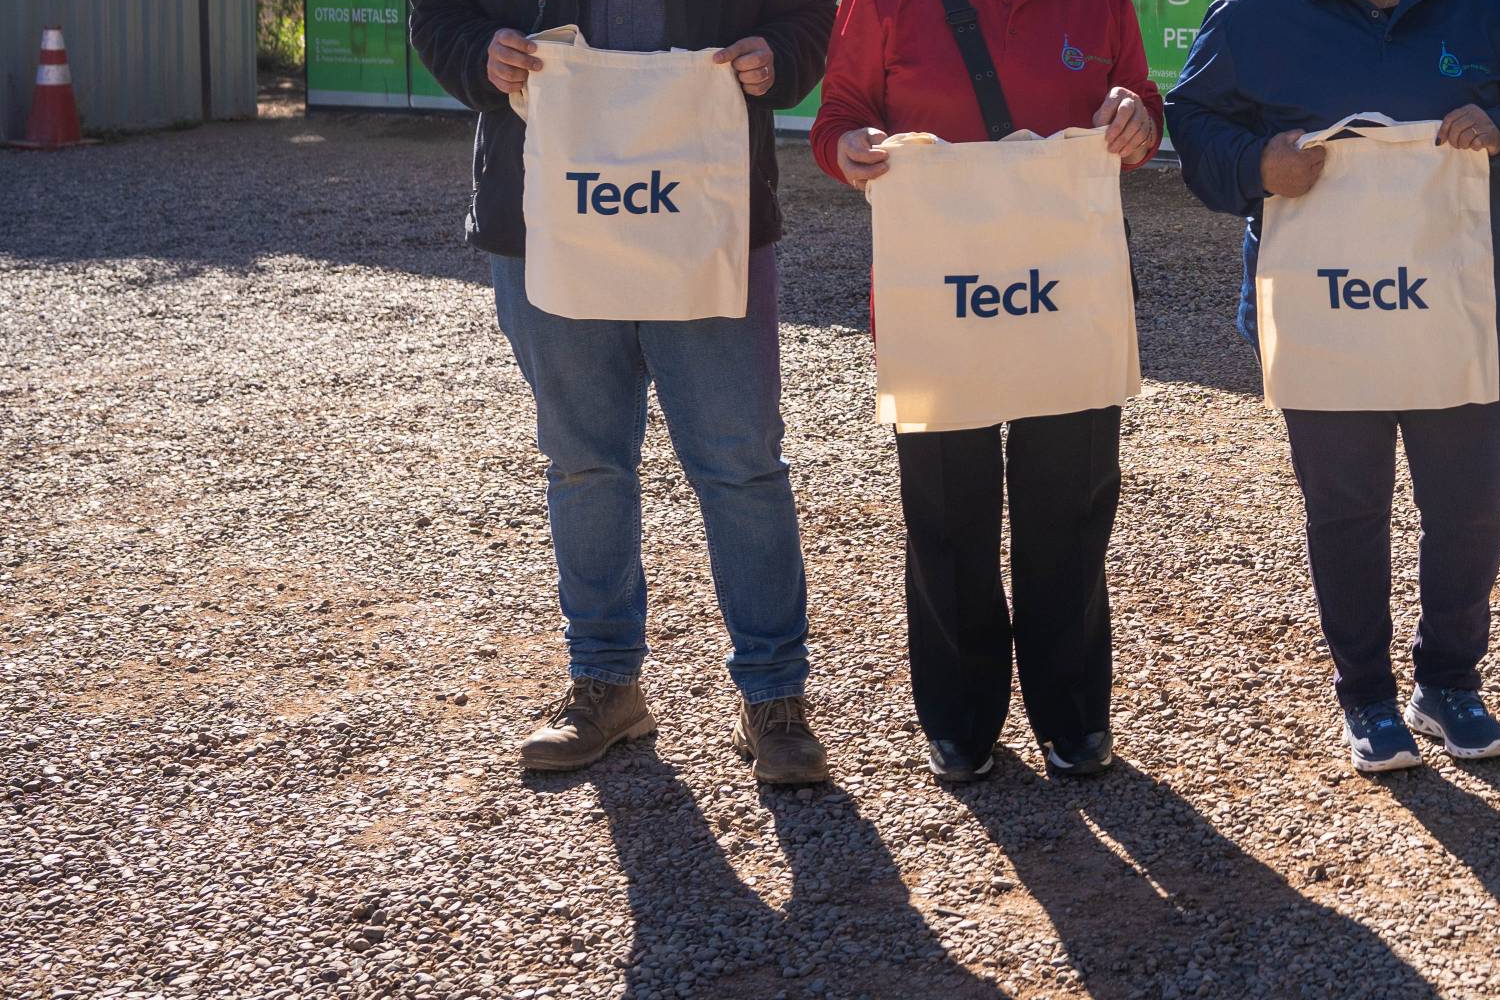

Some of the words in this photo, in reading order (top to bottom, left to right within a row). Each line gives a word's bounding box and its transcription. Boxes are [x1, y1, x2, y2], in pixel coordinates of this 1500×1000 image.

[315, 7, 350, 22] OTROS
[352, 8, 399, 24] METALES
[1164, 28, 1201, 49] PET
[566, 170, 680, 215] Teck
[944, 269, 1060, 318] Teck
[1317, 266, 1429, 311] Teck
